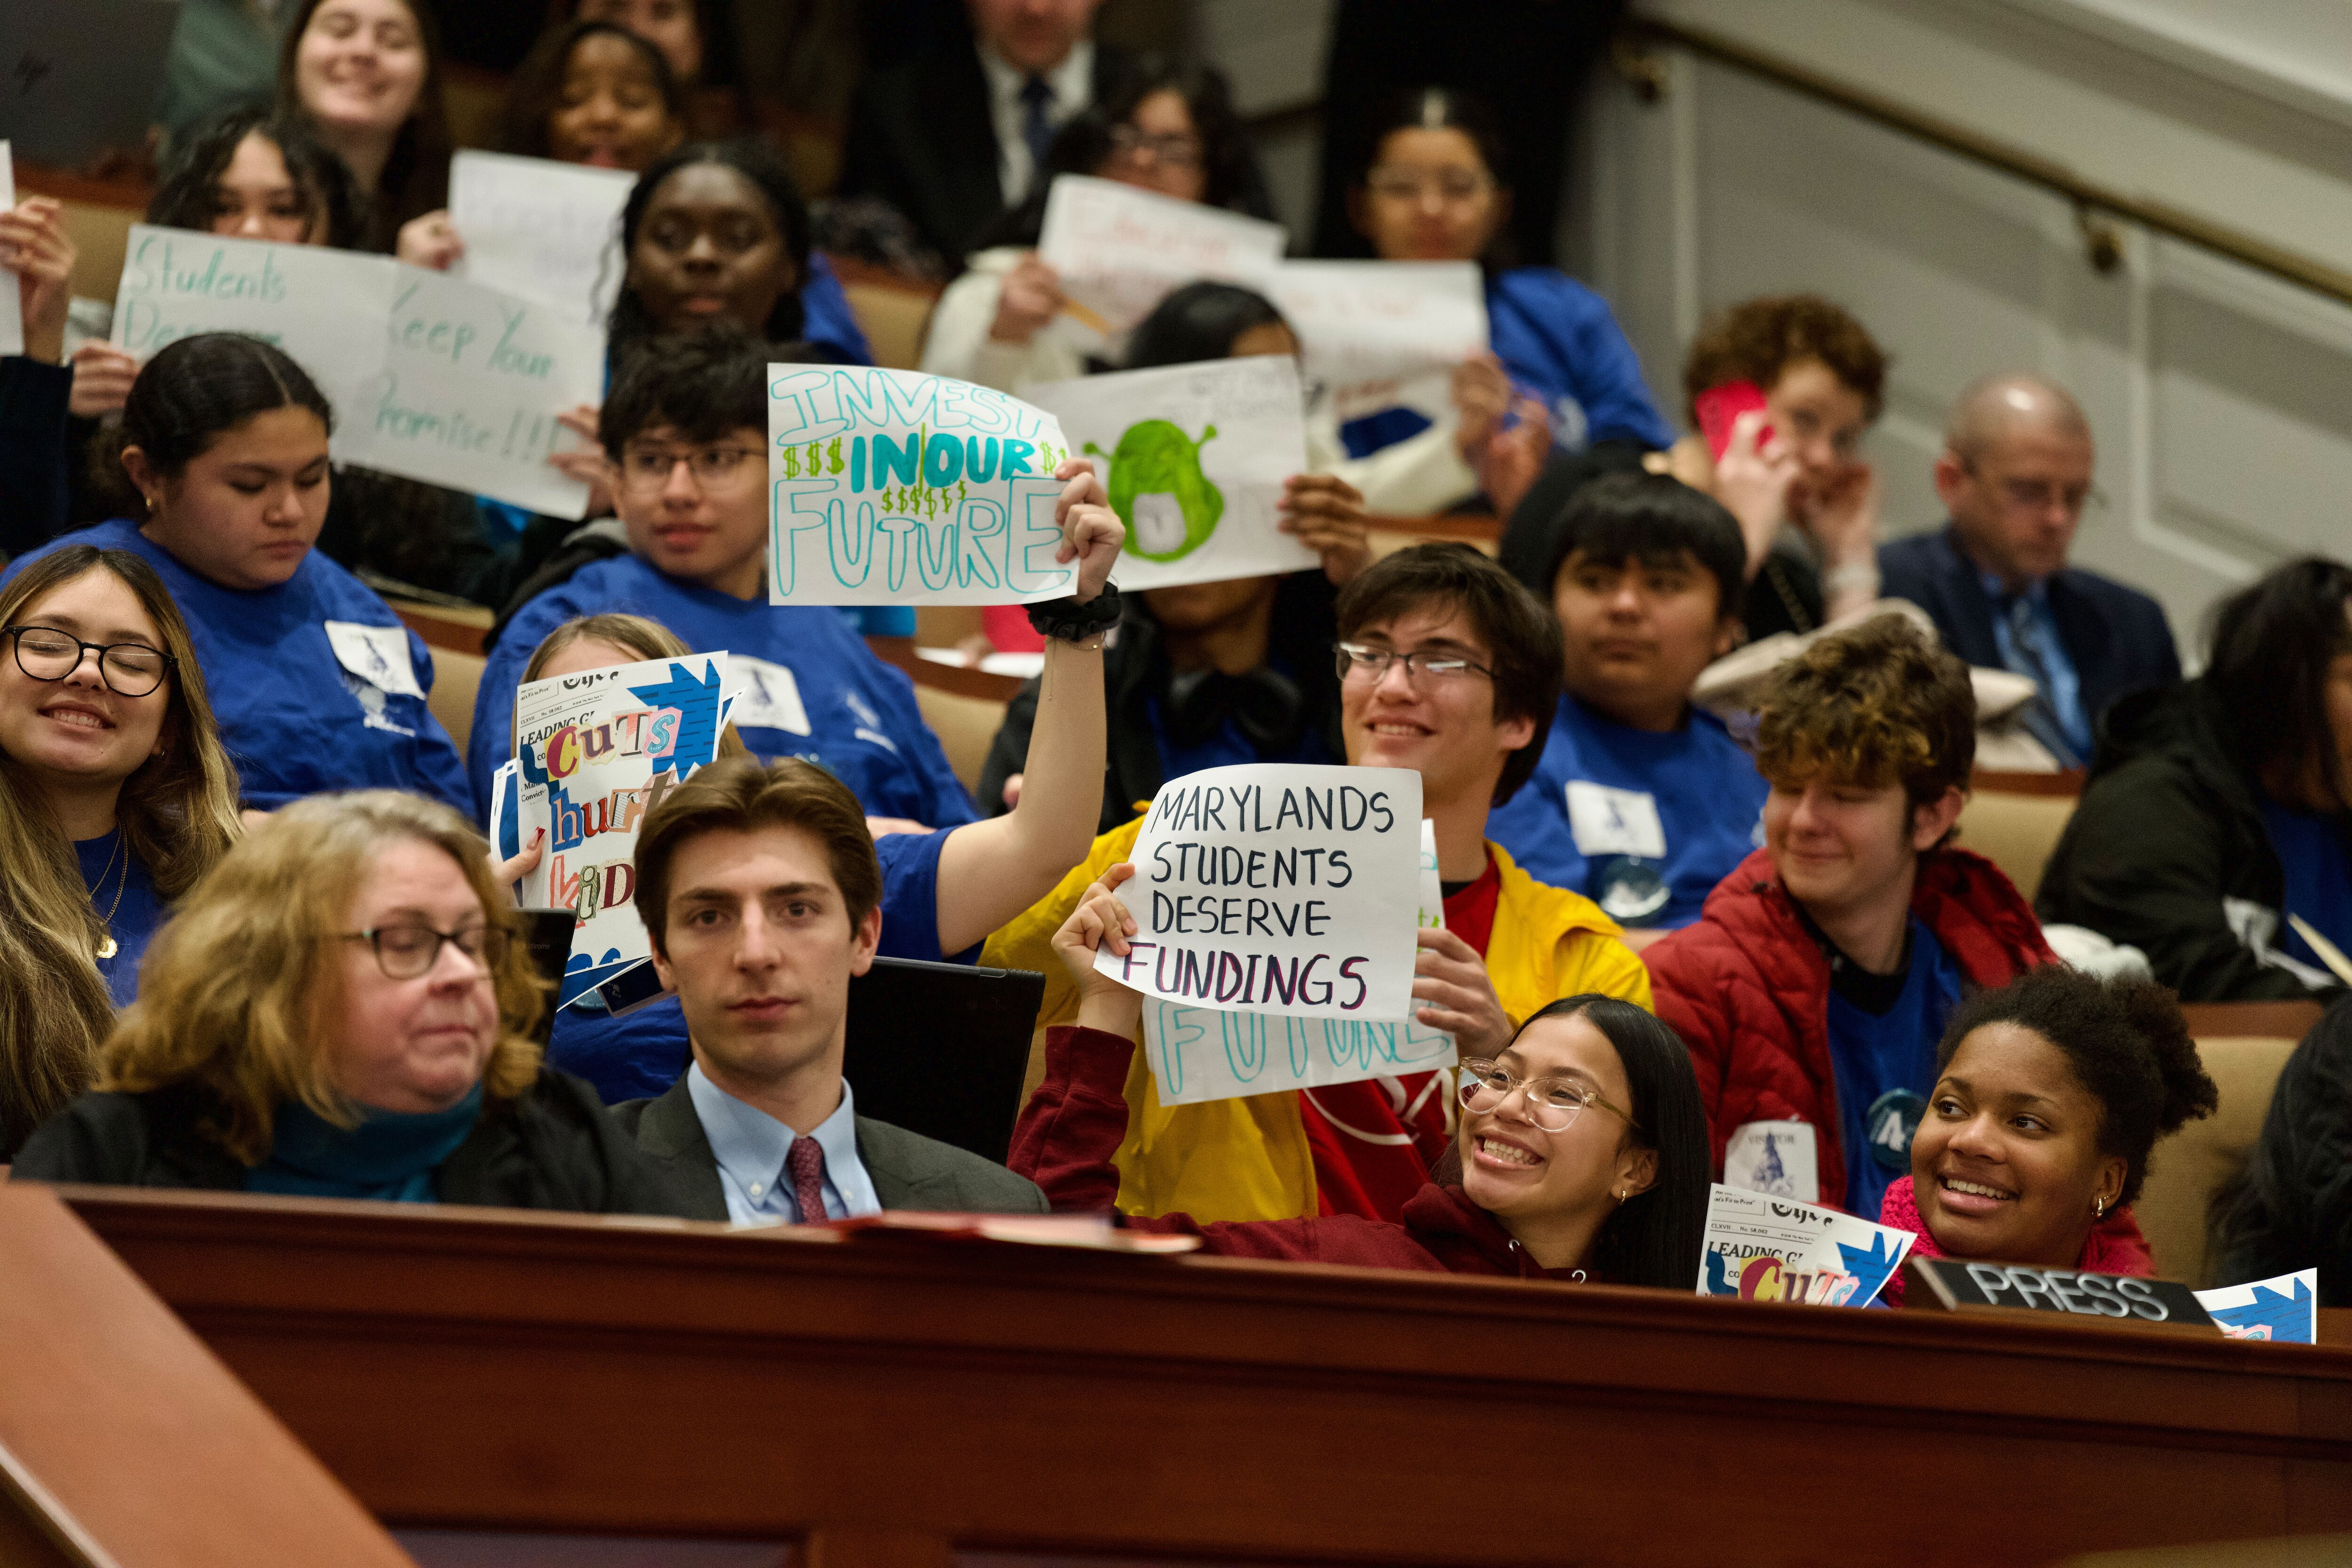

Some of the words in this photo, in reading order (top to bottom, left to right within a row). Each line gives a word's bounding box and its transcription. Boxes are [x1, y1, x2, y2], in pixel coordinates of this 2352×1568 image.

[135, 236, 286, 302] Students
[771, 369, 1054, 446] INVEST
[775, 476, 1071, 597] FUTURE
[521, 788, 546, 802] Convicti
[1150, 784, 1394, 834] MARYLANDS
[1151, 841, 1352, 888] STUDENTS
[1152, 890, 1331, 937] DESERVE
[1122, 941, 1369, 1011] FUNDINGS
[1965, 1262, 2169, 1321] PRESS
